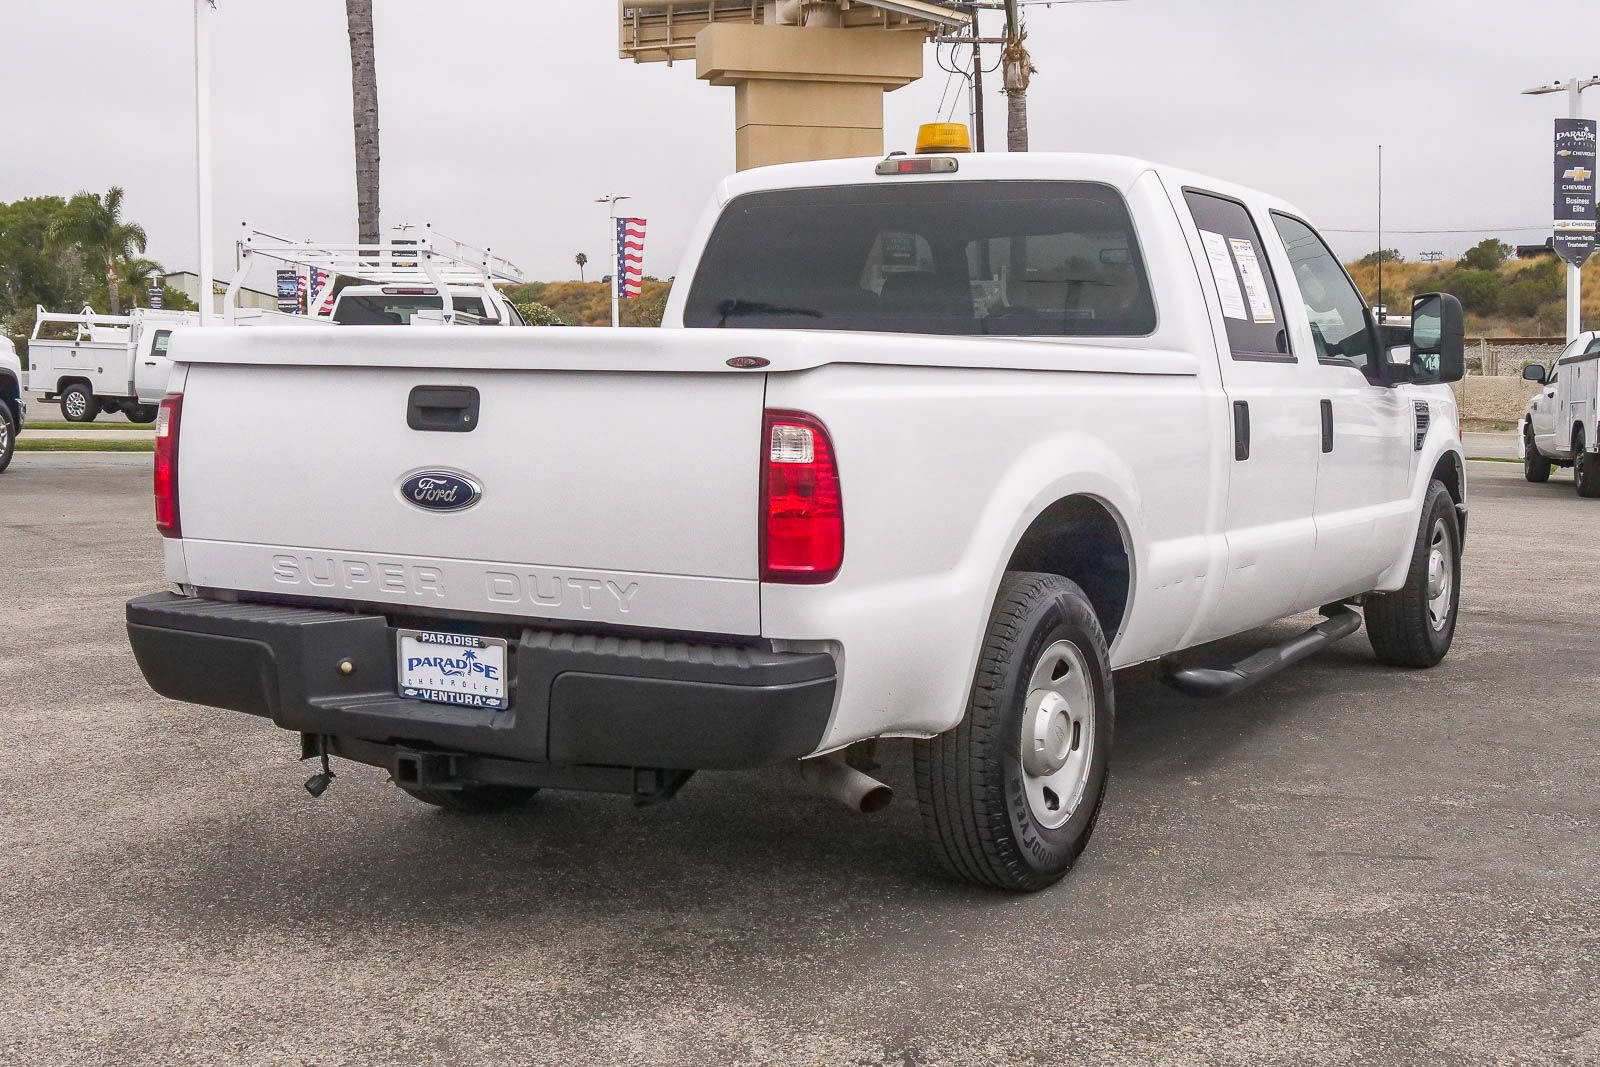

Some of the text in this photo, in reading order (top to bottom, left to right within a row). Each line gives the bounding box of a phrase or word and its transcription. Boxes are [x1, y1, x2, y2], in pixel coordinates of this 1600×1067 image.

[1556, 128, 1595, 142] PARADISE
[1565, 197, 1590, 205] Business
[1572, 205, 1585, 213] Elite
[414, 477, 459, 503] Ford
[271, 553, 640, 613] SUPER DUTY
[421, 632, 479, 647] PARADISE
[408, 651, 499, 681] PARADISE
[408, 678, 499, 695] CHEVROLET
